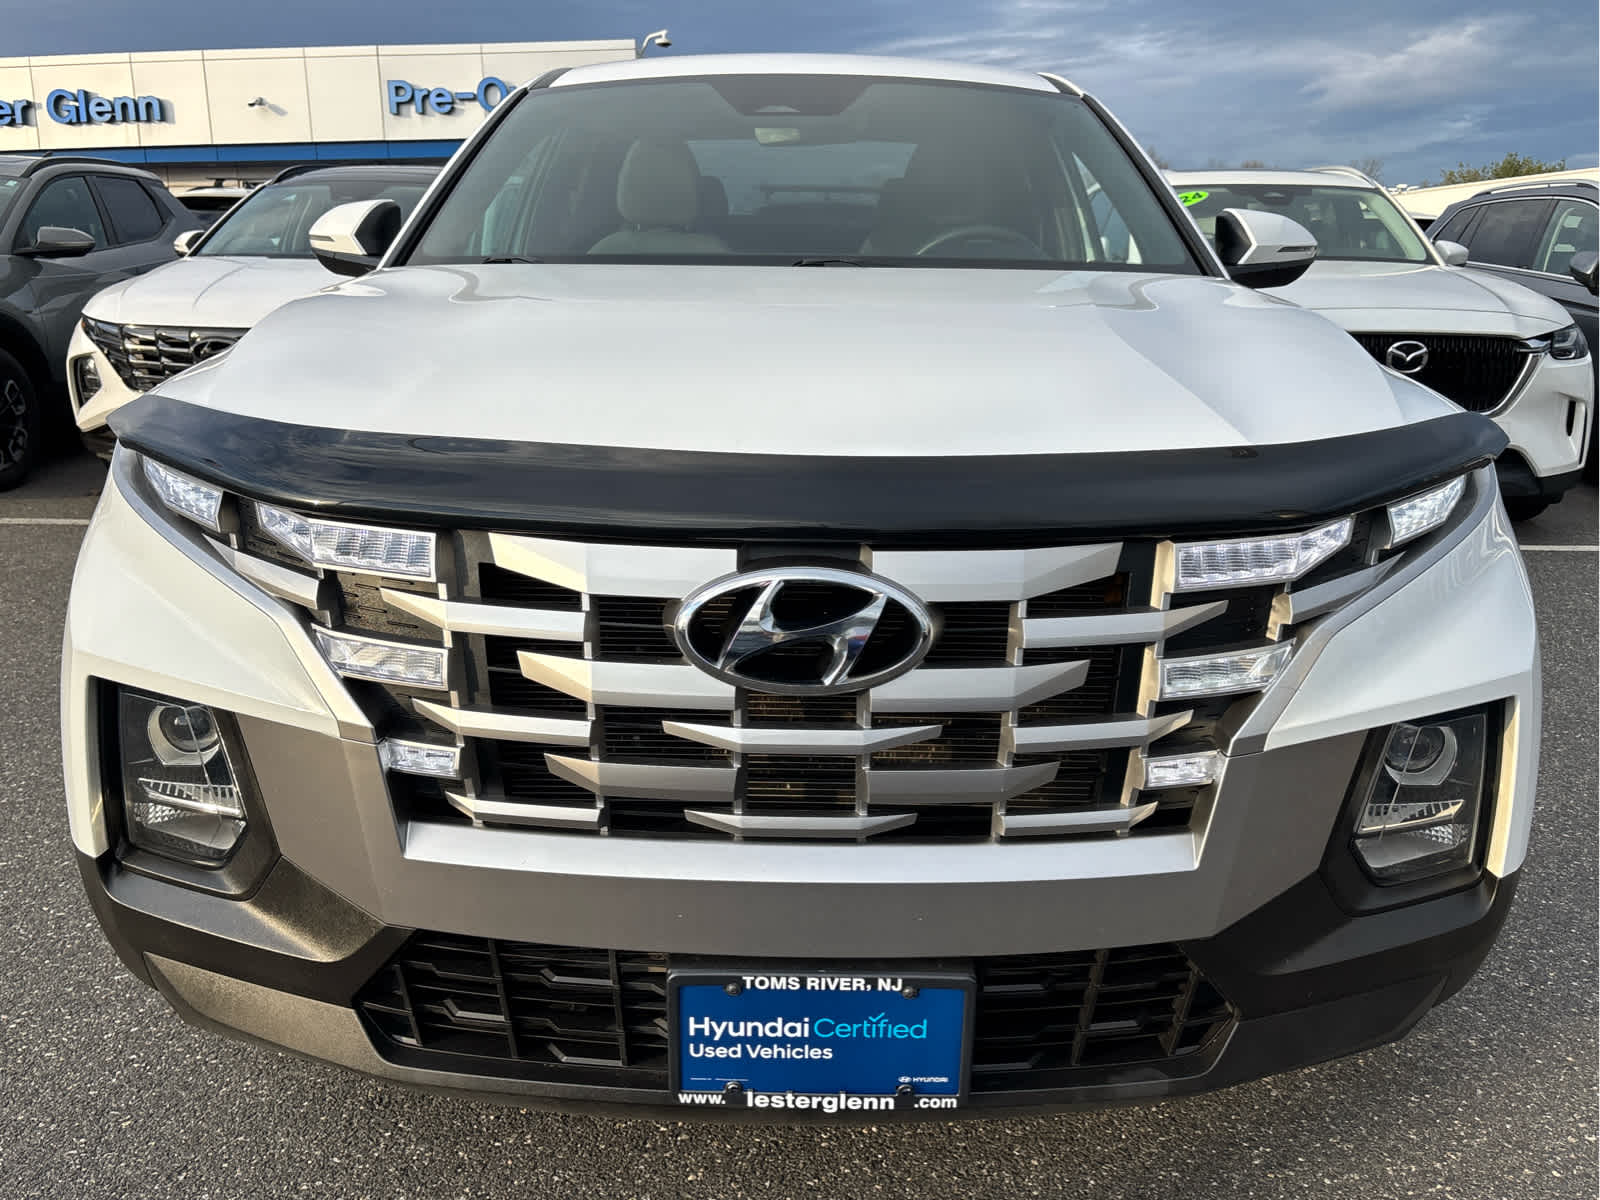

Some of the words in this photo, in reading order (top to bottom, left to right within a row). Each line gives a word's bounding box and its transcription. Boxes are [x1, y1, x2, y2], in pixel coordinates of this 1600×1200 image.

[46, 88, 161, 124] Glenn
[387, 76, 517, 114] Pre-O
[742, 976, 801, 990] TOMS
[806, 977, 871, 992] RIVER,
[877, 978, 903, 992] NJ
[688, 1016, 810, 1041] Hyundai
[813, 1012, 928, 1039] Certified
[689, 1043, 742, 1058] Used
[746, 1044, 833, 1060] Vehicles
[678, 1092, 726, 1105] www.
[746, 1091, 895, 1113] lesterglenn
[913, 1097, 958, 1109] .com
